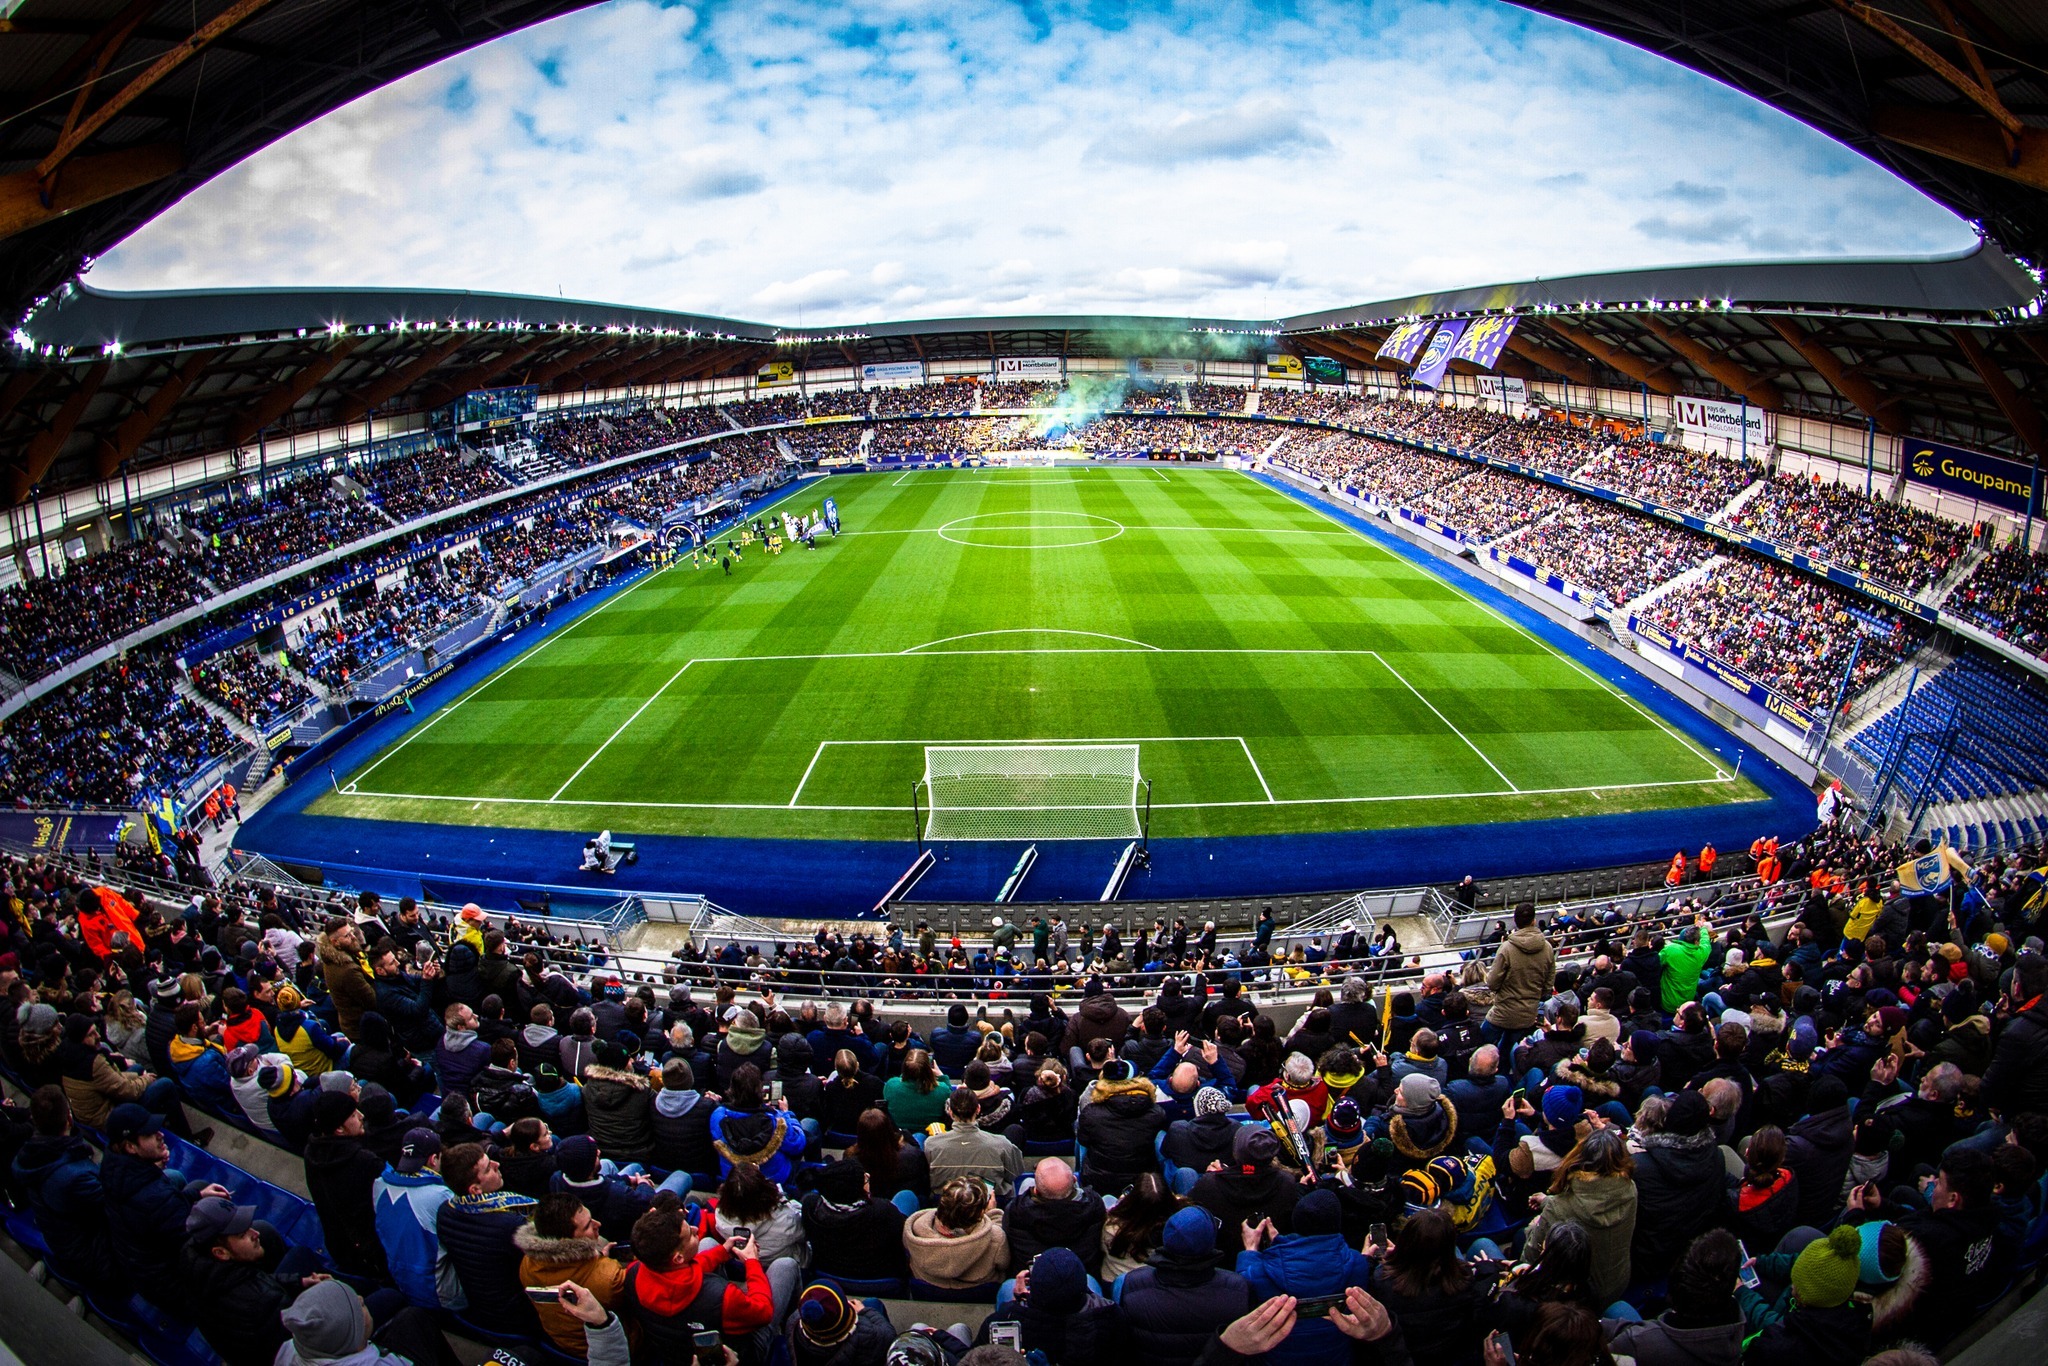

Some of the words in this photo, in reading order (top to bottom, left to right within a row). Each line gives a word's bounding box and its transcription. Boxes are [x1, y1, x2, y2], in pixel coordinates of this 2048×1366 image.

[1719, 406, 1727, 414] de
[1707, 411, 1761, 430] Montbélard
[1708, 422, 1762, 438] AGGLOMÉRTION
[1941, 459, 2032, 498] Groupama
[281, 607, 294, 618] le
[300, 596, 316, 610] FC
[320, 544, 437, 600] Sochaux-Montbéliard
[455, 525, 489, 543] disputé
[512, 505, 546, 522] matches
[549, 501, 557, 509] de
[596, 480, 619, 493] emporté
[1808, 559, 1828, 572] Kyriad
[1862, 582, 1915, 611] PHOTO-STYLE
[1707, 661, 1718, 672] Ville
[32, 823, 54, 847] Néolia
